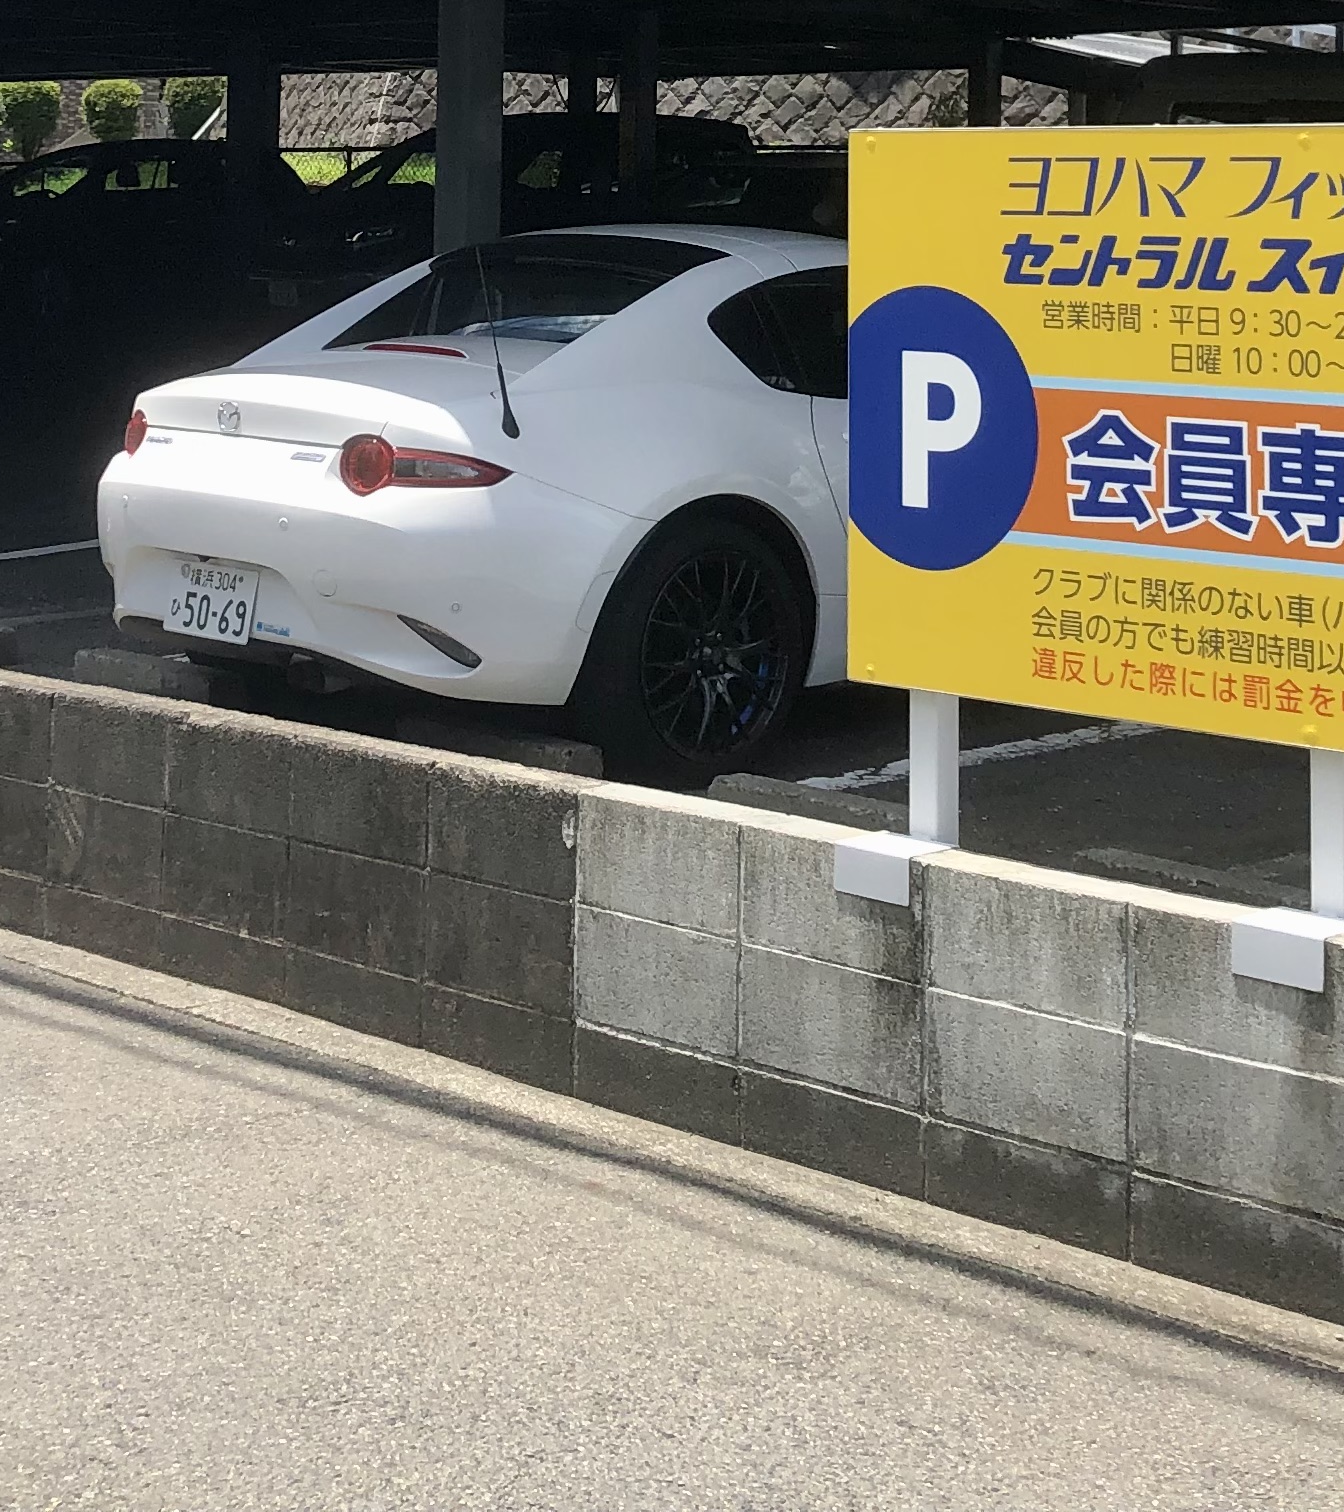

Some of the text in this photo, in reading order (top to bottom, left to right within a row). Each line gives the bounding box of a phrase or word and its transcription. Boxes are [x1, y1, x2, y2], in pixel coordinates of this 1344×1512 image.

[1000, 156, 1206, 219] ヨコハマ
[1002, 234, 1236, 291] セントラル
[901, 351, 983, 509] P
